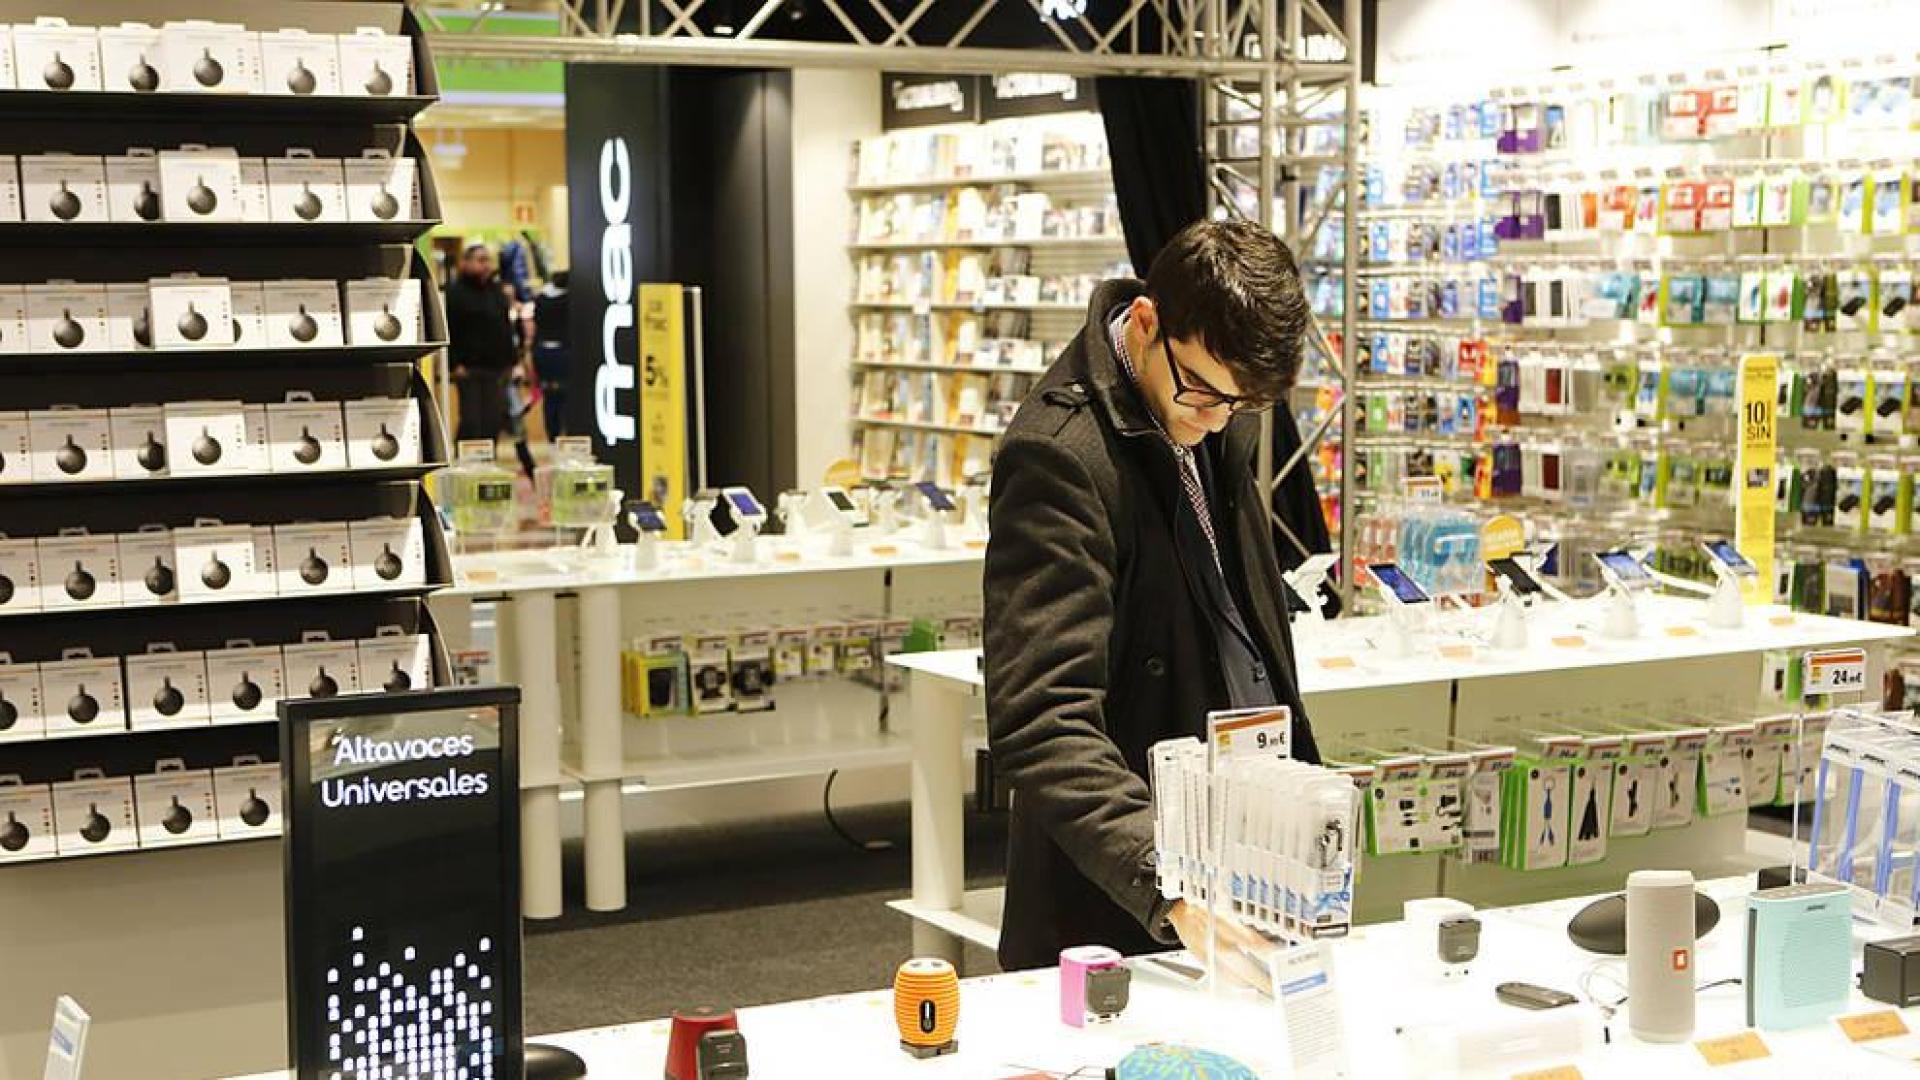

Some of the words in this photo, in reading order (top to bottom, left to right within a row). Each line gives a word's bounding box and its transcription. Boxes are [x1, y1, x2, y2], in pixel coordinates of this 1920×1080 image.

[595, 137, 636, 446] fnac
[333, 735, 473, 767] Altavoces
[322, 768, 489, 807] Universales
